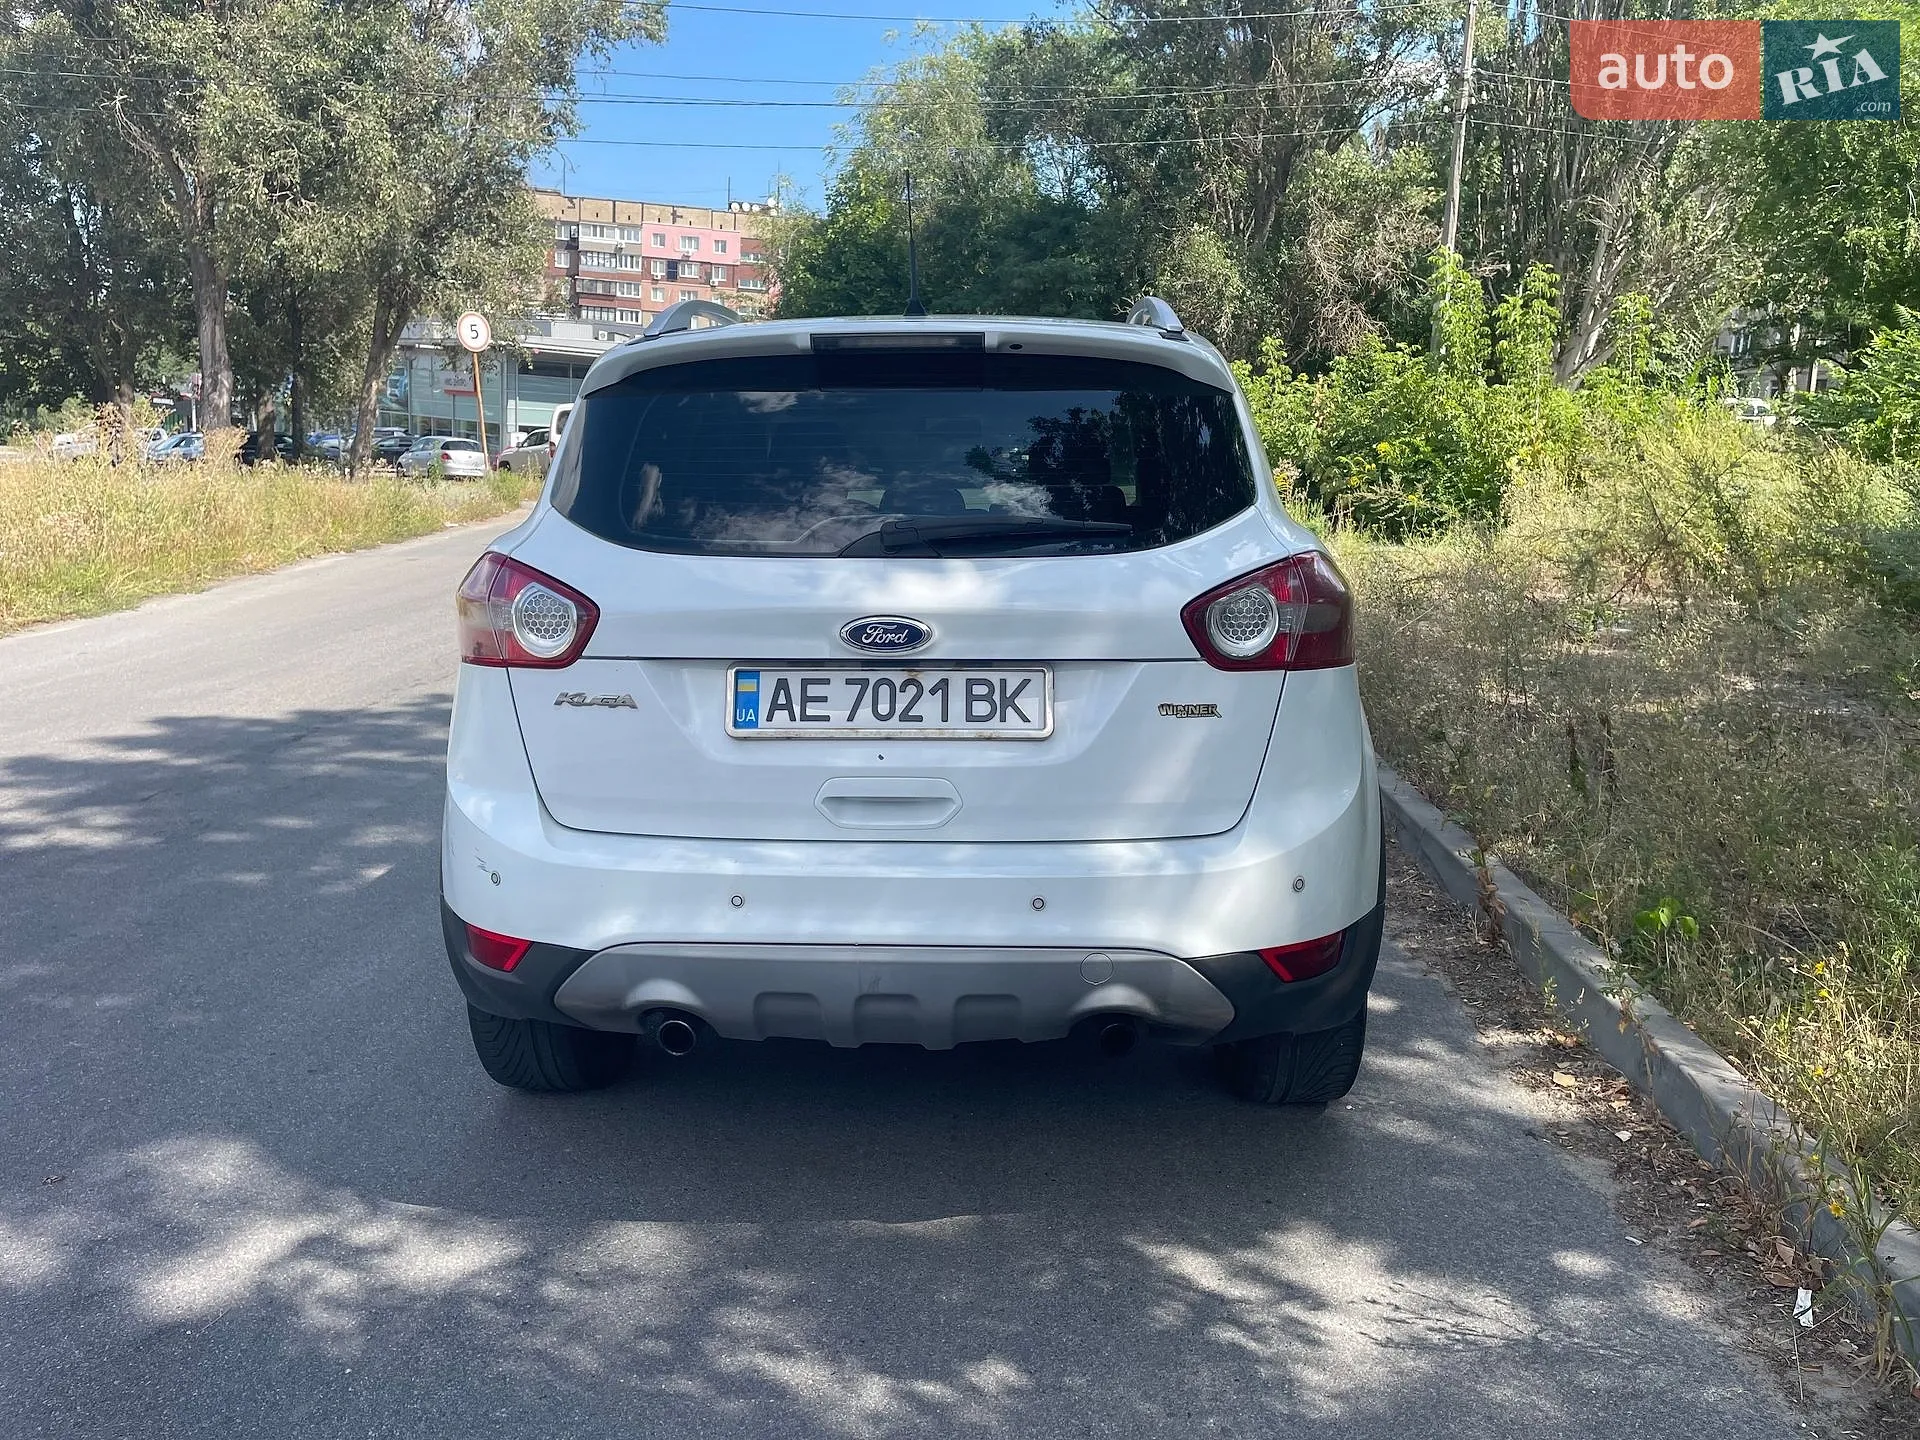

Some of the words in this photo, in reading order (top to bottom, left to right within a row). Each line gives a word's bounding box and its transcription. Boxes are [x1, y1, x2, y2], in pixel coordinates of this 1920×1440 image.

[470, 324, 479, 339] 5
[862, 623, 908, 645] Ford
[554, 692, 638, 709] KUGA
[766, 678, 831, 722] AE
[845, 678, 950, 722] 7021
[965, 678, 1032, 723] BK
[736, 708, 756, 723] UA
[1158, 704, 1222, 718] WINNER
